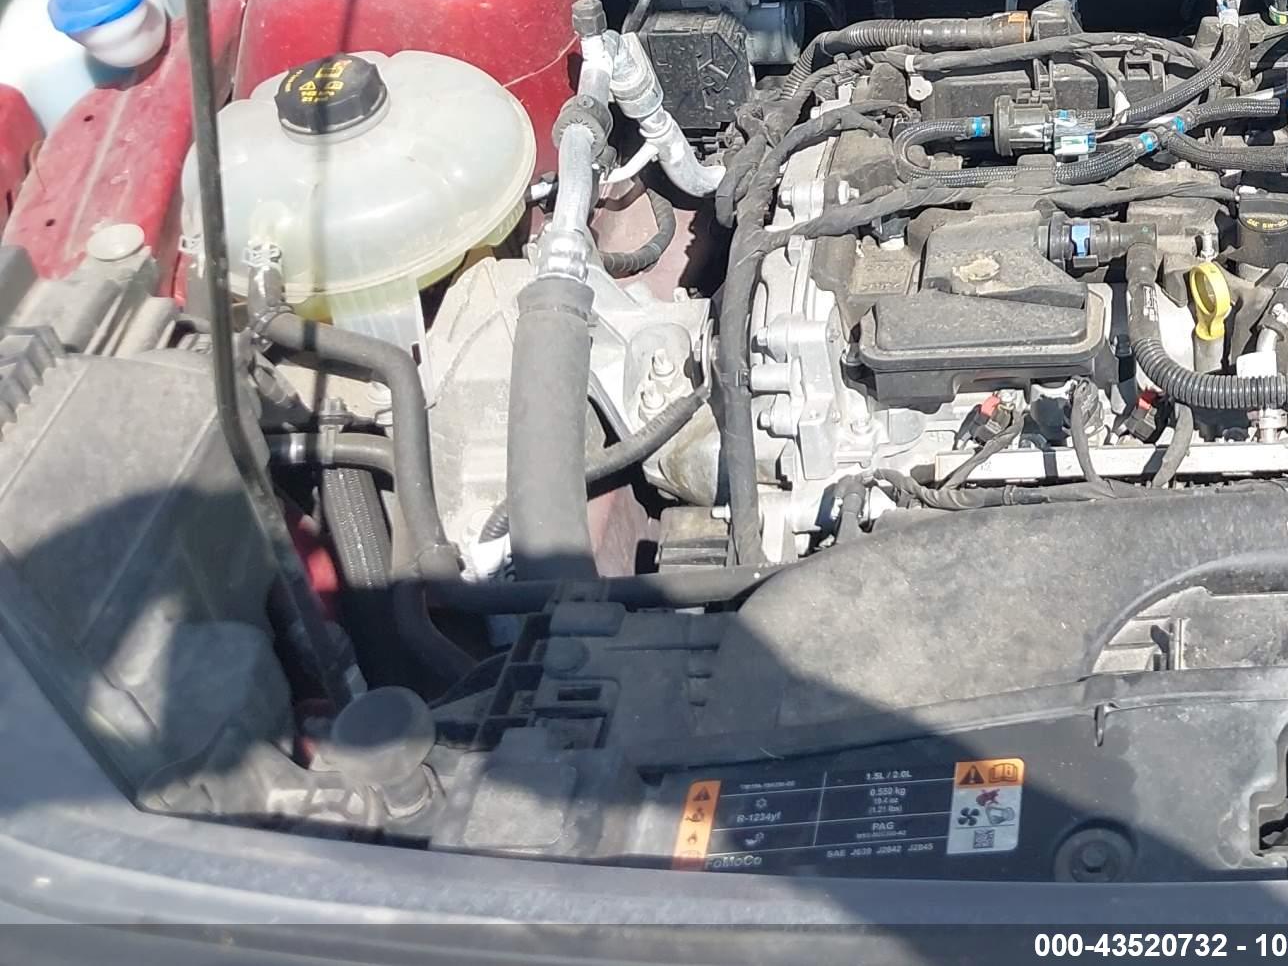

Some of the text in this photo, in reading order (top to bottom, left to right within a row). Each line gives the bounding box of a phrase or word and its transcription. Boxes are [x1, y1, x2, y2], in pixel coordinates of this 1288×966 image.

[736, 810, 783, 825] R-1234yf
[872, 821, 896, 831] PAG
[826, 849, 847, 858] SAE
[705, 854, 763, 869] FoMoCo
